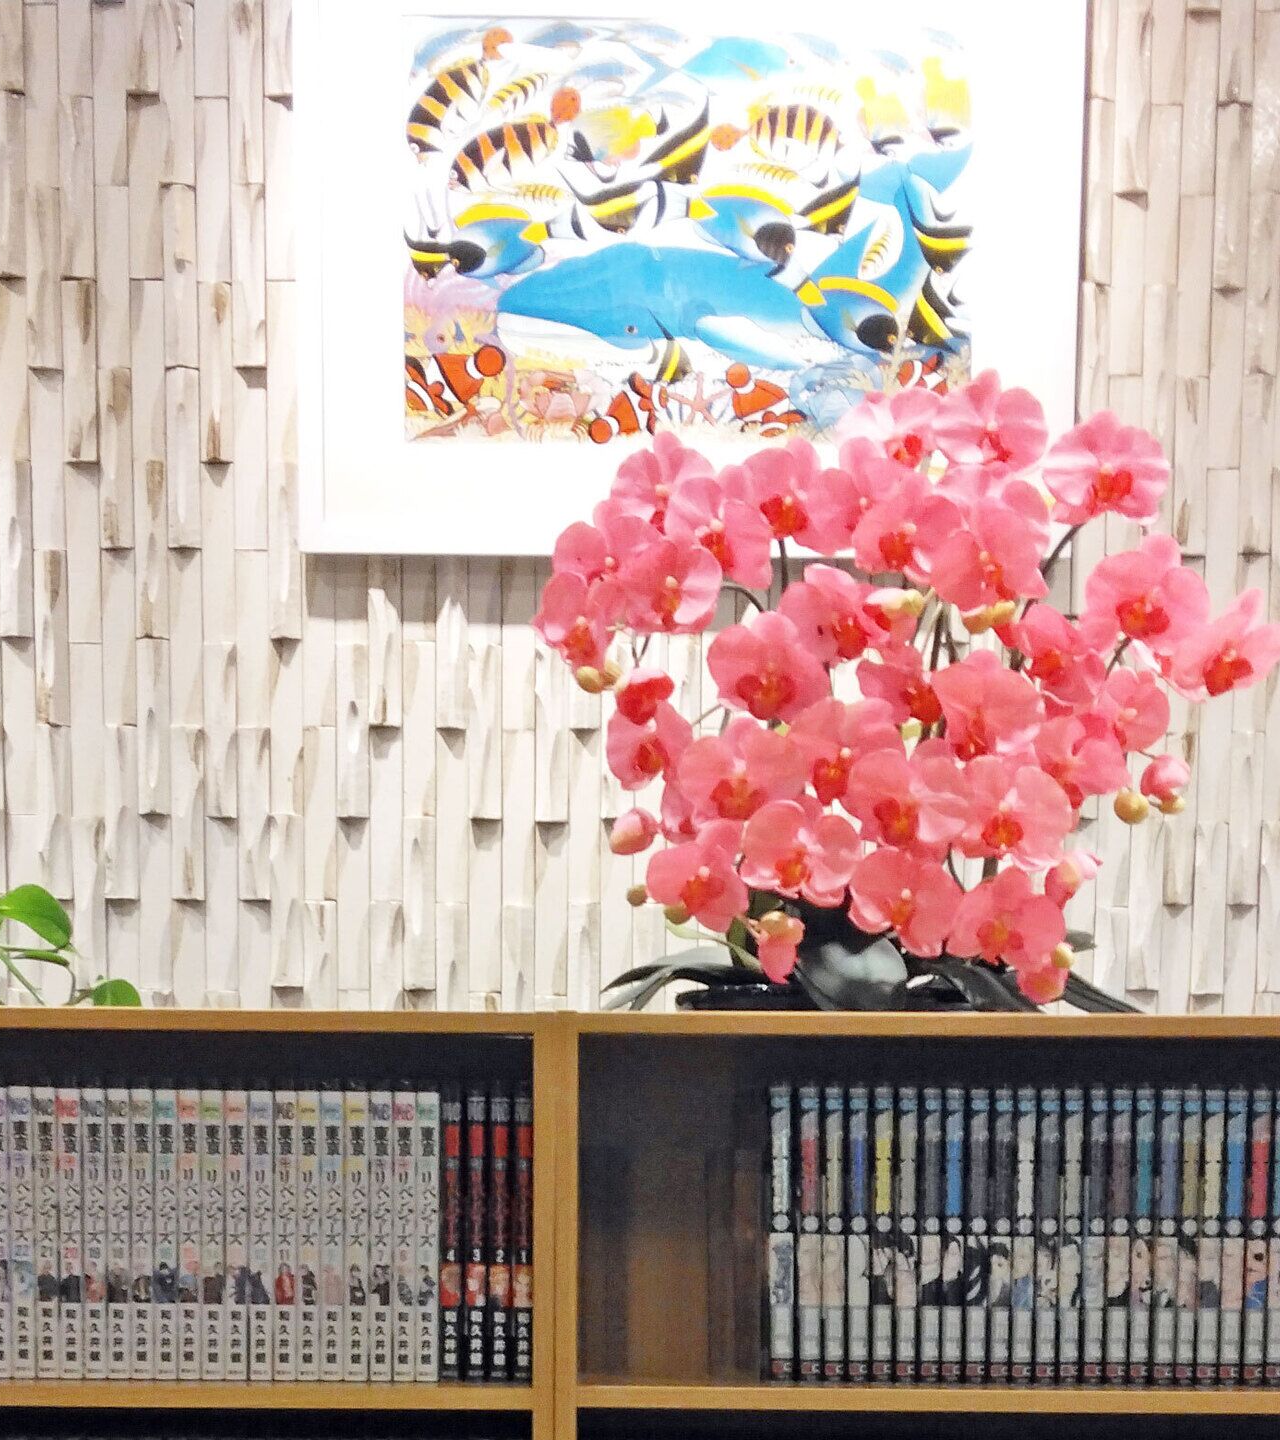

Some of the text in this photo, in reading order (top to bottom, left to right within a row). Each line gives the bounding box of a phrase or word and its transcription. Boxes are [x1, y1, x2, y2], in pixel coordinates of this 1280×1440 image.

[446, 1249, 455, 1262] 4
[473, 1249, 481, 1262] 3
[495, 1249, 504, 1262] 2
[521, 1250, 527, 1262] 1
